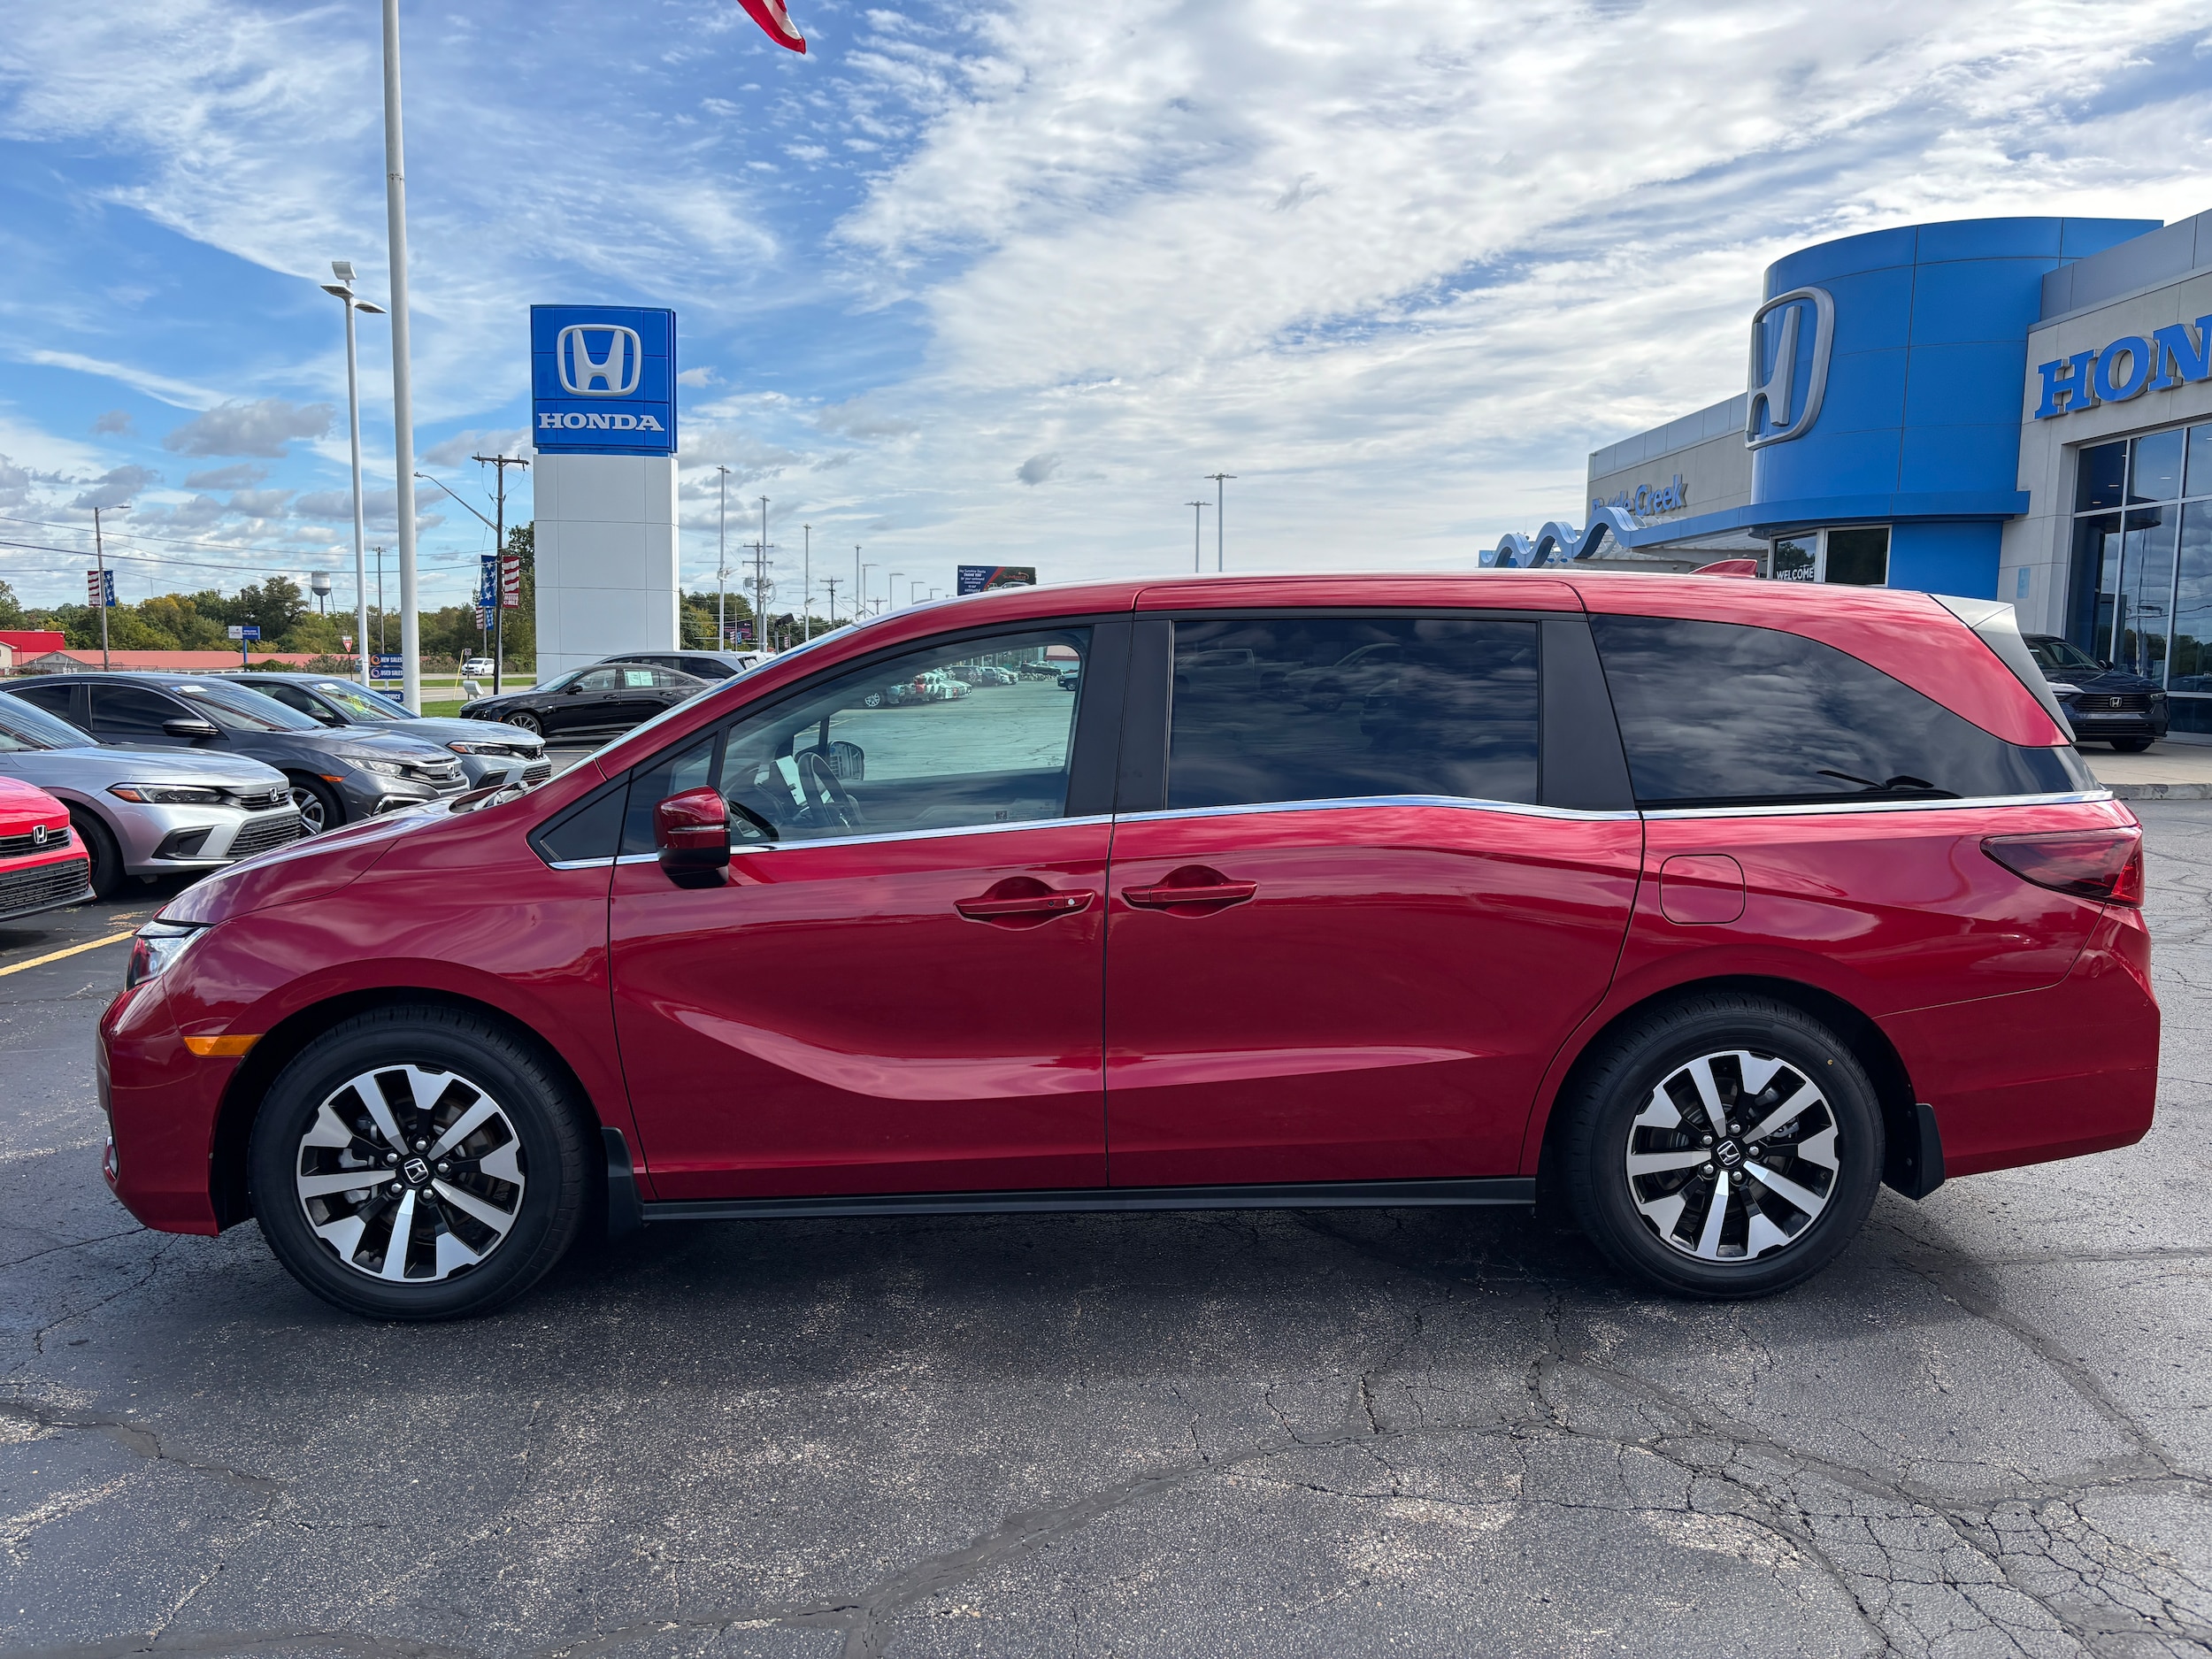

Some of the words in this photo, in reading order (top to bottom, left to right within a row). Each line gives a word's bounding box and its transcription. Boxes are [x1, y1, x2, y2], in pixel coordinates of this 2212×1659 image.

[538, 412, 664, 432] HONDA
[1635, 474, 1683, 516] Creek
[1776, 567, 1814, 580] WELCOME
